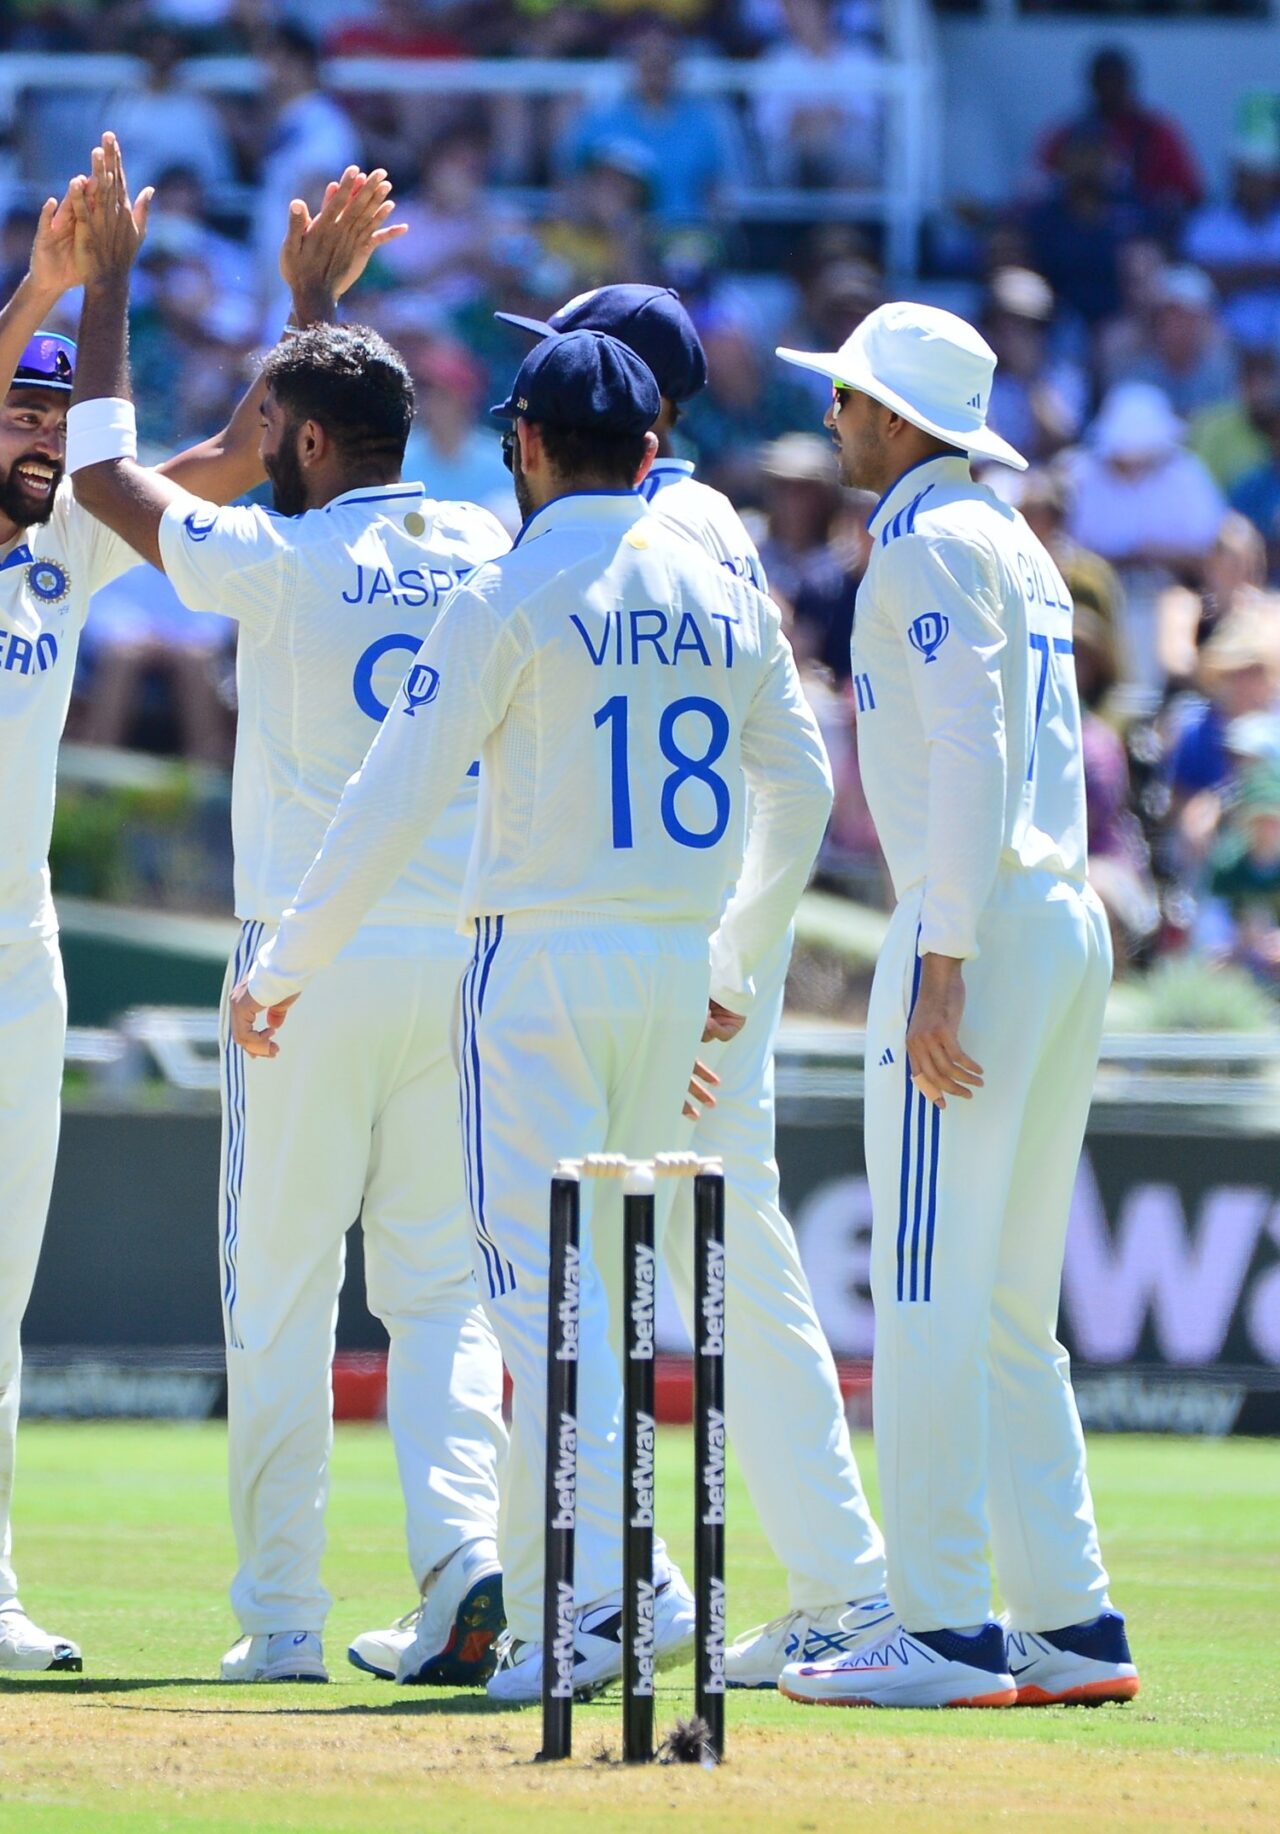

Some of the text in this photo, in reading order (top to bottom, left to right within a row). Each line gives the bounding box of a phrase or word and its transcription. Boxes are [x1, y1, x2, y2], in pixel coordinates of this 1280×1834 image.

[342, 564, 472, 607] JASP
[570, 609, 739, 668] VIRAT
[1017, 551, 1070, 612] GILL
[593, 694, 731, 849] 18
[554, 1243, 580, 1361] betway
[629, 1243, 656, 1360] betway
[700, 1239, 725, 1356] betway
[551, 1411, 577, 1530] betway
[630, 1411, 656, 1528] betway
[702, 1408, 726, 1525] betway
[550, 1580, 575, 1698] betway
[631, 1580, 656, 1696] betway
[703, 1577, 726, 1694] betway
